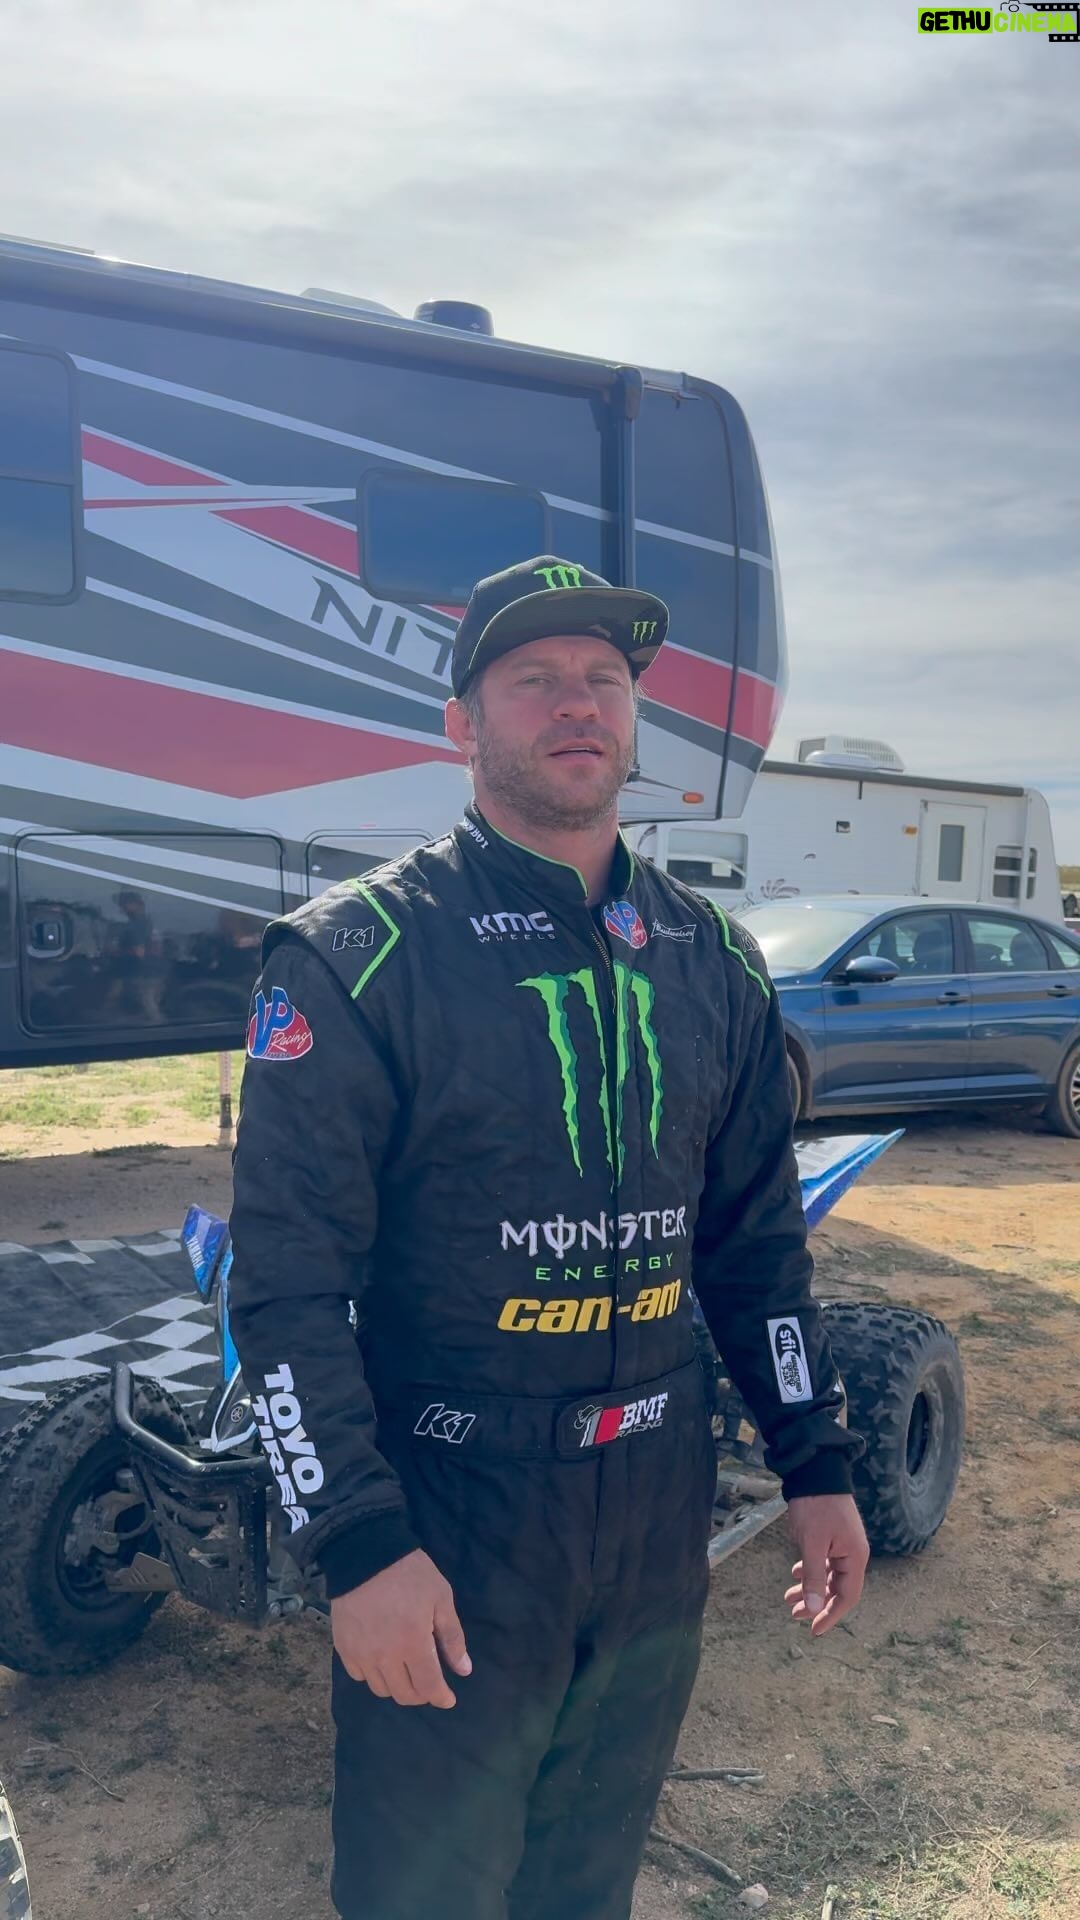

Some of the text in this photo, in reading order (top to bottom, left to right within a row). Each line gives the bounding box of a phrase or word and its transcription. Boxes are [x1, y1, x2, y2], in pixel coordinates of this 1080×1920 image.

[332, 925, 375, 952] K1
[478, 933, 556, 943] WHEELS
[251, 986, 295, 1057] VP
[271, 1028, 311, 1052] Racing
[500, 1205, 687, 1260] MONSTER
[186, 1234, 206, 1271] YAMAHA
[535, 1252, 674, 1281] ENERGY
[497, 1278, 682, 1334] can-am
[780, 1329, 797, 1351] sfi
[264, 1363, 325, 1494] TOYO
[413, 1403, 477, 1445] K1
[614, 1418, 664, 1438] RACING
[618, 1392, 669, 1431] BMF
